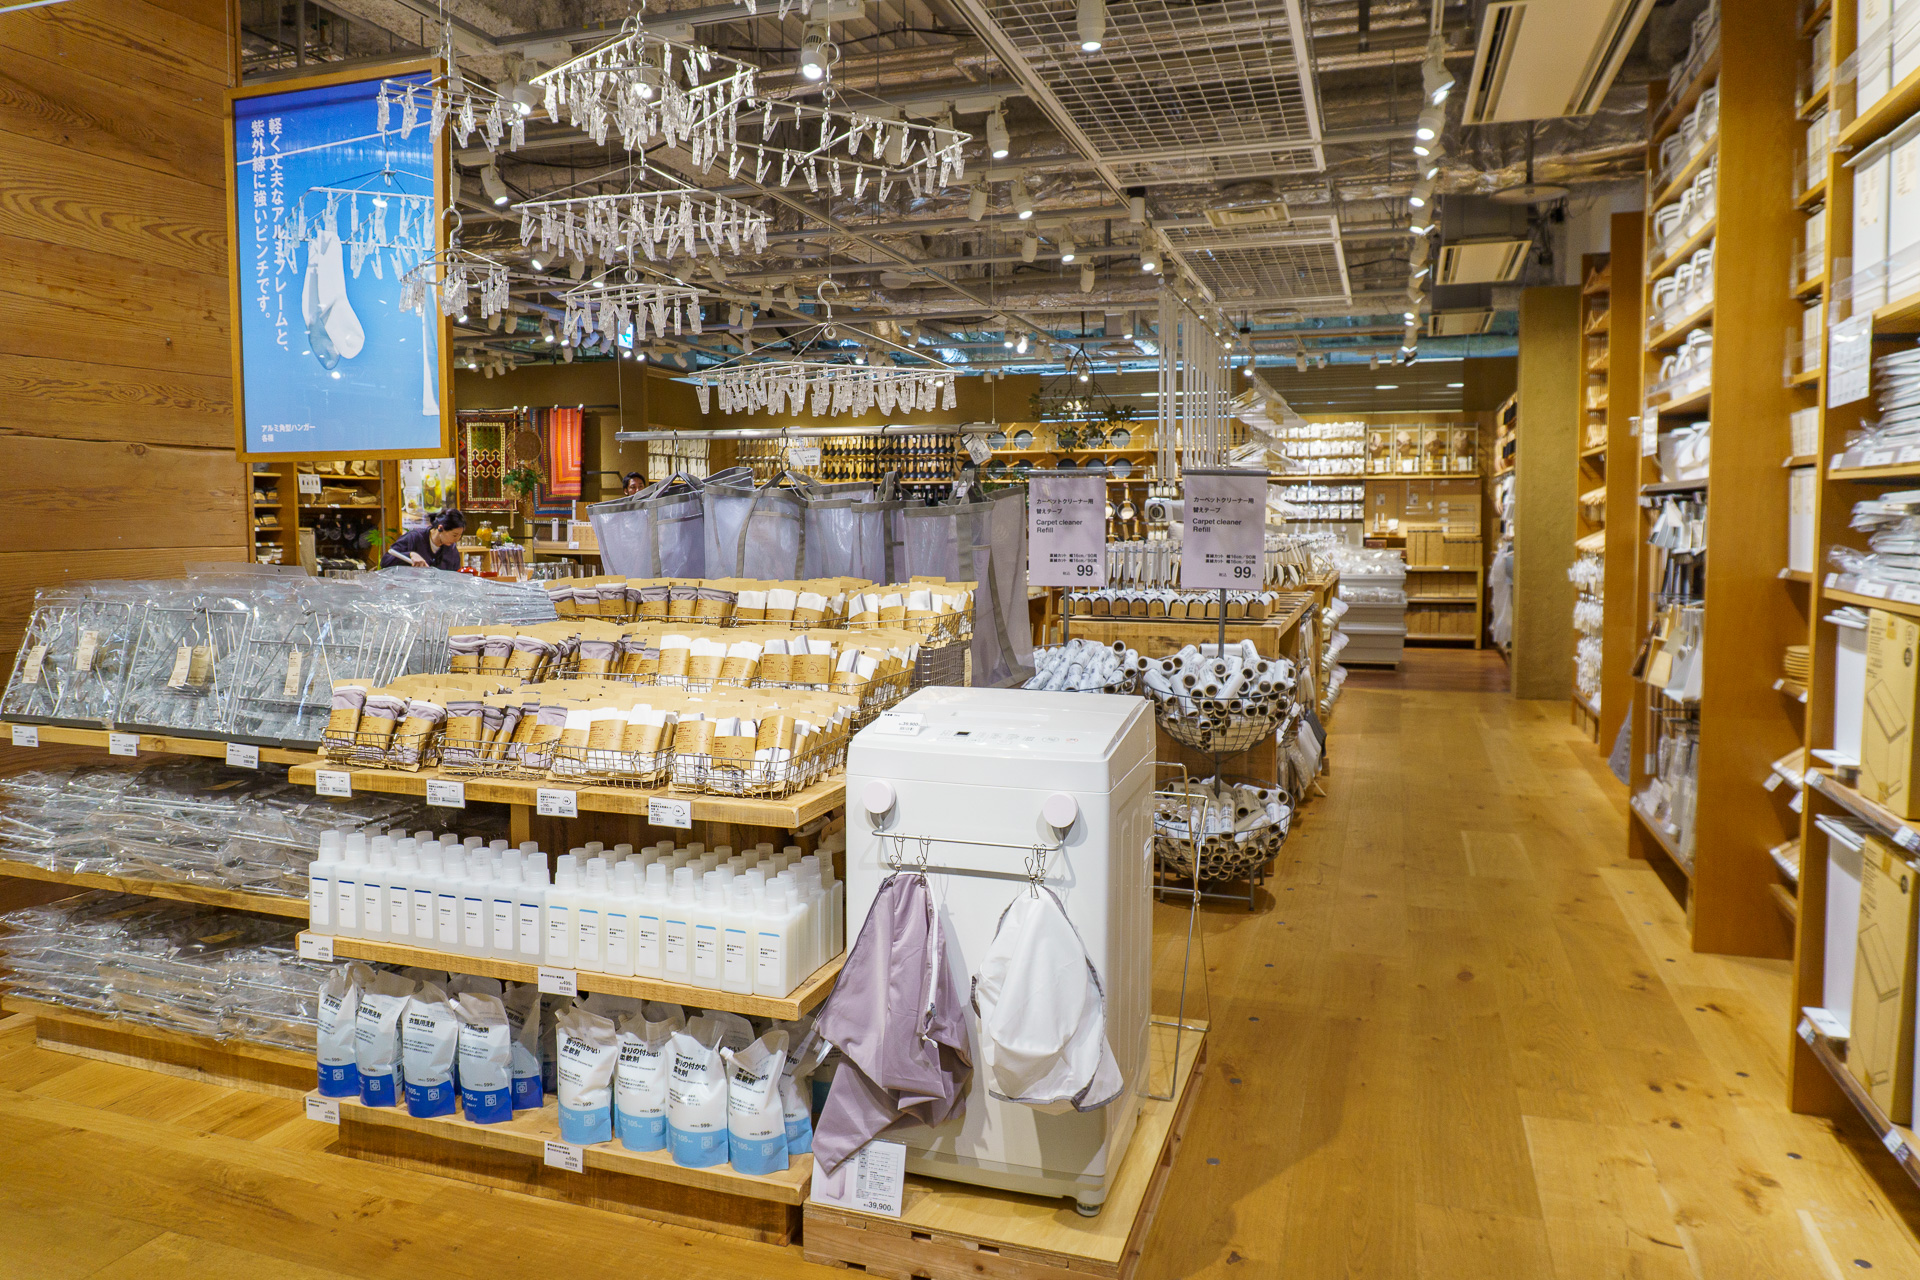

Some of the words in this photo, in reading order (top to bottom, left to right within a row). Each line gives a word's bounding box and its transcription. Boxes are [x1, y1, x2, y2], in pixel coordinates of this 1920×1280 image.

[251, 120, 271, 319] 紫外線に強いピンチです。
[1192, 517, 1216, 526] Carpet
[1216, 518, 1242, 526] cleaner
[1036, 526, 1054, 534] Refill
[1193, 525, 1211, 533] Refill
